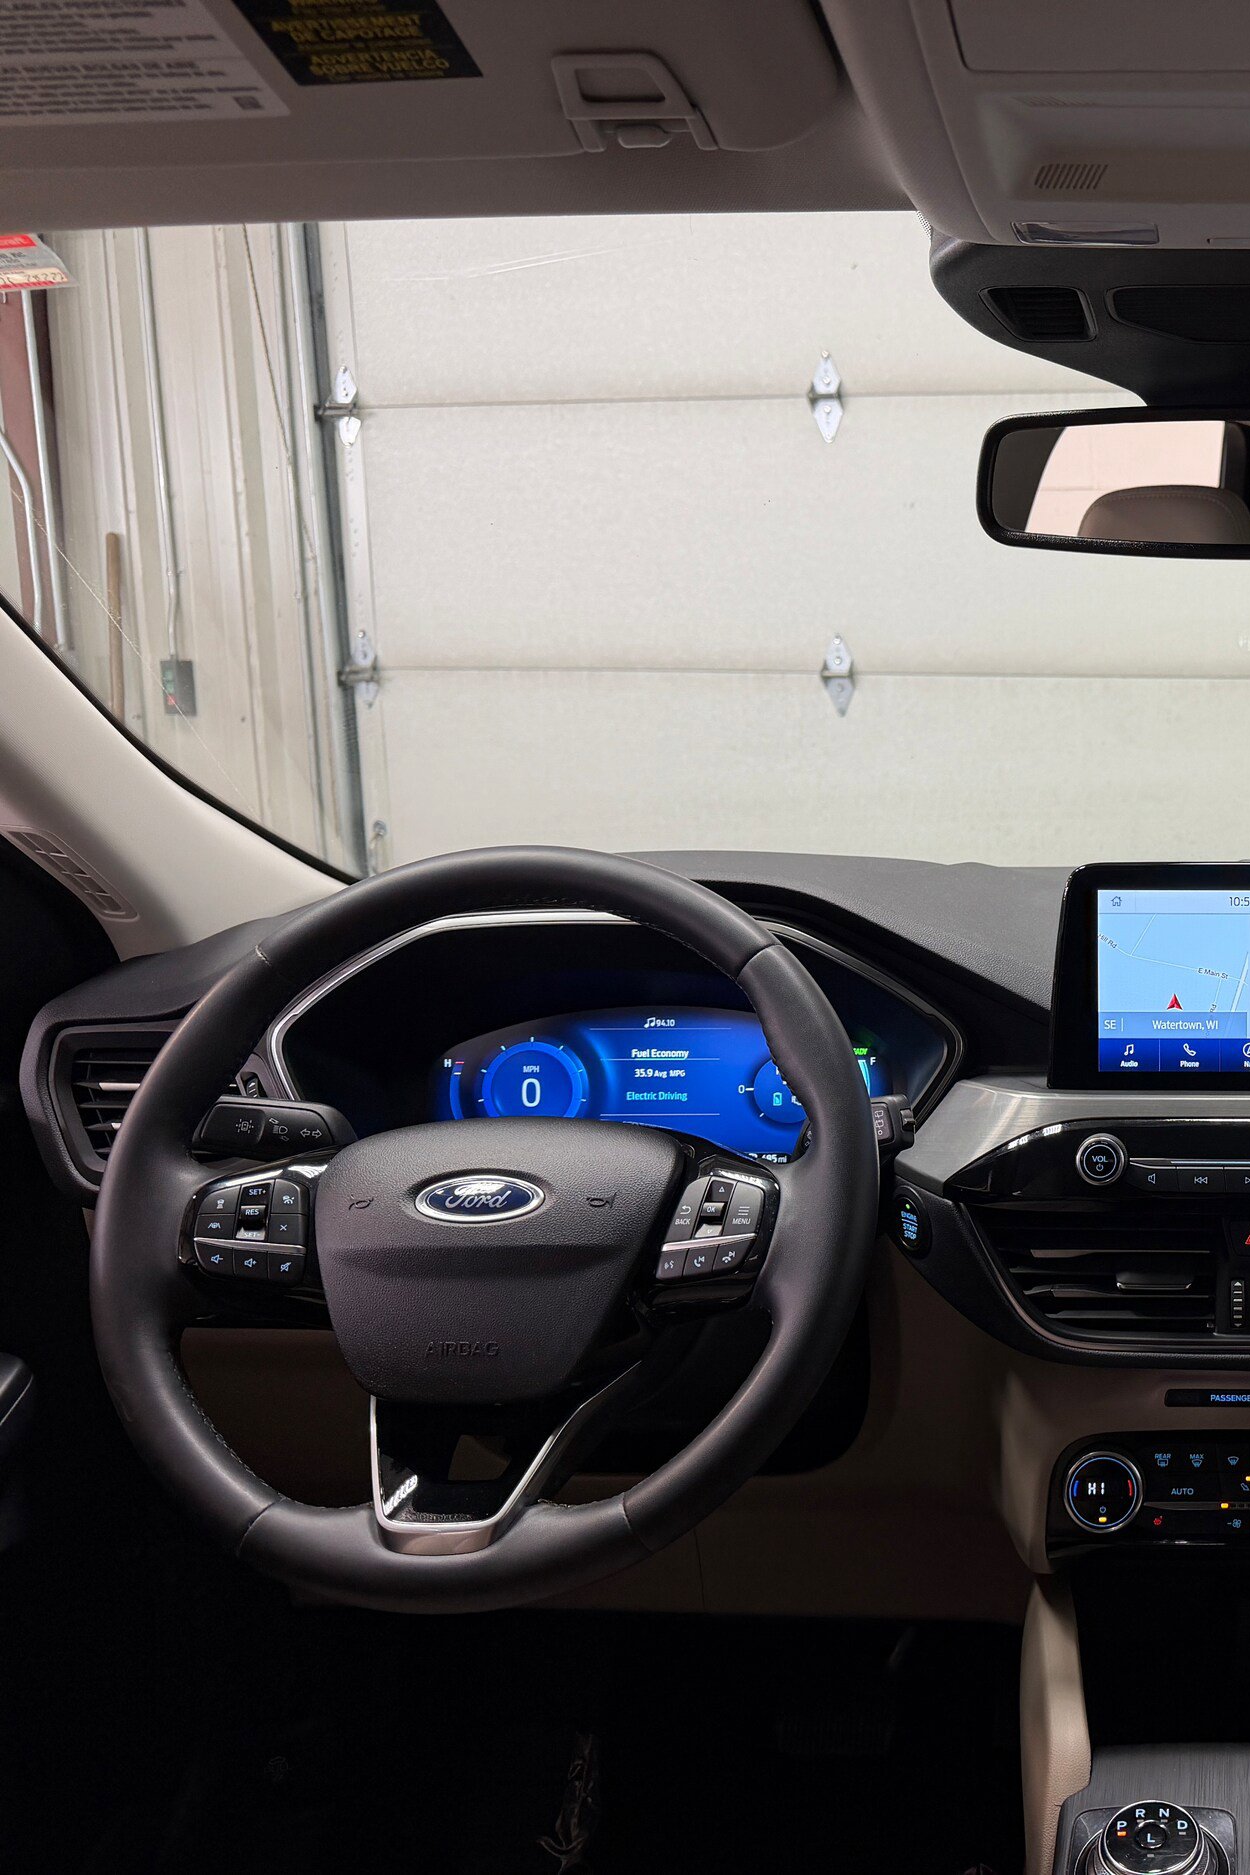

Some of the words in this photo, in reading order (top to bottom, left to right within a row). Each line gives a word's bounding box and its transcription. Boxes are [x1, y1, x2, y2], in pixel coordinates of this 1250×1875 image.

[1198, 967, 1204, 975] E
[1204, 969, 1220, 978] Main
[1220, 972, 1229, 980] St
[656, 1018, 676, 1028] 94.10
[1104, 1019, 1115, 1030] SE
[1152, 1019, 1205, 1031] Watertown,
[1206, 1020, 1219, 1030] WI
[631, 1048, 650, 1058] Fuel
[652, 1048, 690, 1060] Economy
[444, 1059, 451, 1067] H
[870, 1056, 876, 1066] F
[1120, 1059, 1139, 1068] Audio
[1180, 1060, 1200, 1068] Phone
[522, 1065, 540, 1073] MPH
[634, 1068, 653, 1078] 35.9
[653, 1069, 668, 1079] Avg
[669, 1069, 686, 1078] MPG
[522, 1078, 540, 1107] 0
[738, 1085, 745, 1093] 0
[626, 1091, 657, 1101] Electric
[658, 1091, 688, 1102] Driving
[778, 1155, 788, 1163] mi
[1092, 1155, 1109, 1163] VOL
[445, 1183, 513, 1208] Ford
[245, 1208, 260, 1216] RES
[732, 1217, 751, 1225] MENU
[902, 1222, 918, 1233] START
[903, 1230, 917, 1240] STOP
[424, 1341, 500, 1358] AIRBAG
[1170, 1487, 1194, 1496] AUTO
[1135, 1808, 1146, 1818] R
[1158, 1808, 1170, 1818] N
[1116, 1820, 1128, 1831] P
[1177, 1820, 1188, 1830] D
[1146, 1832, 1156, 1843] L
